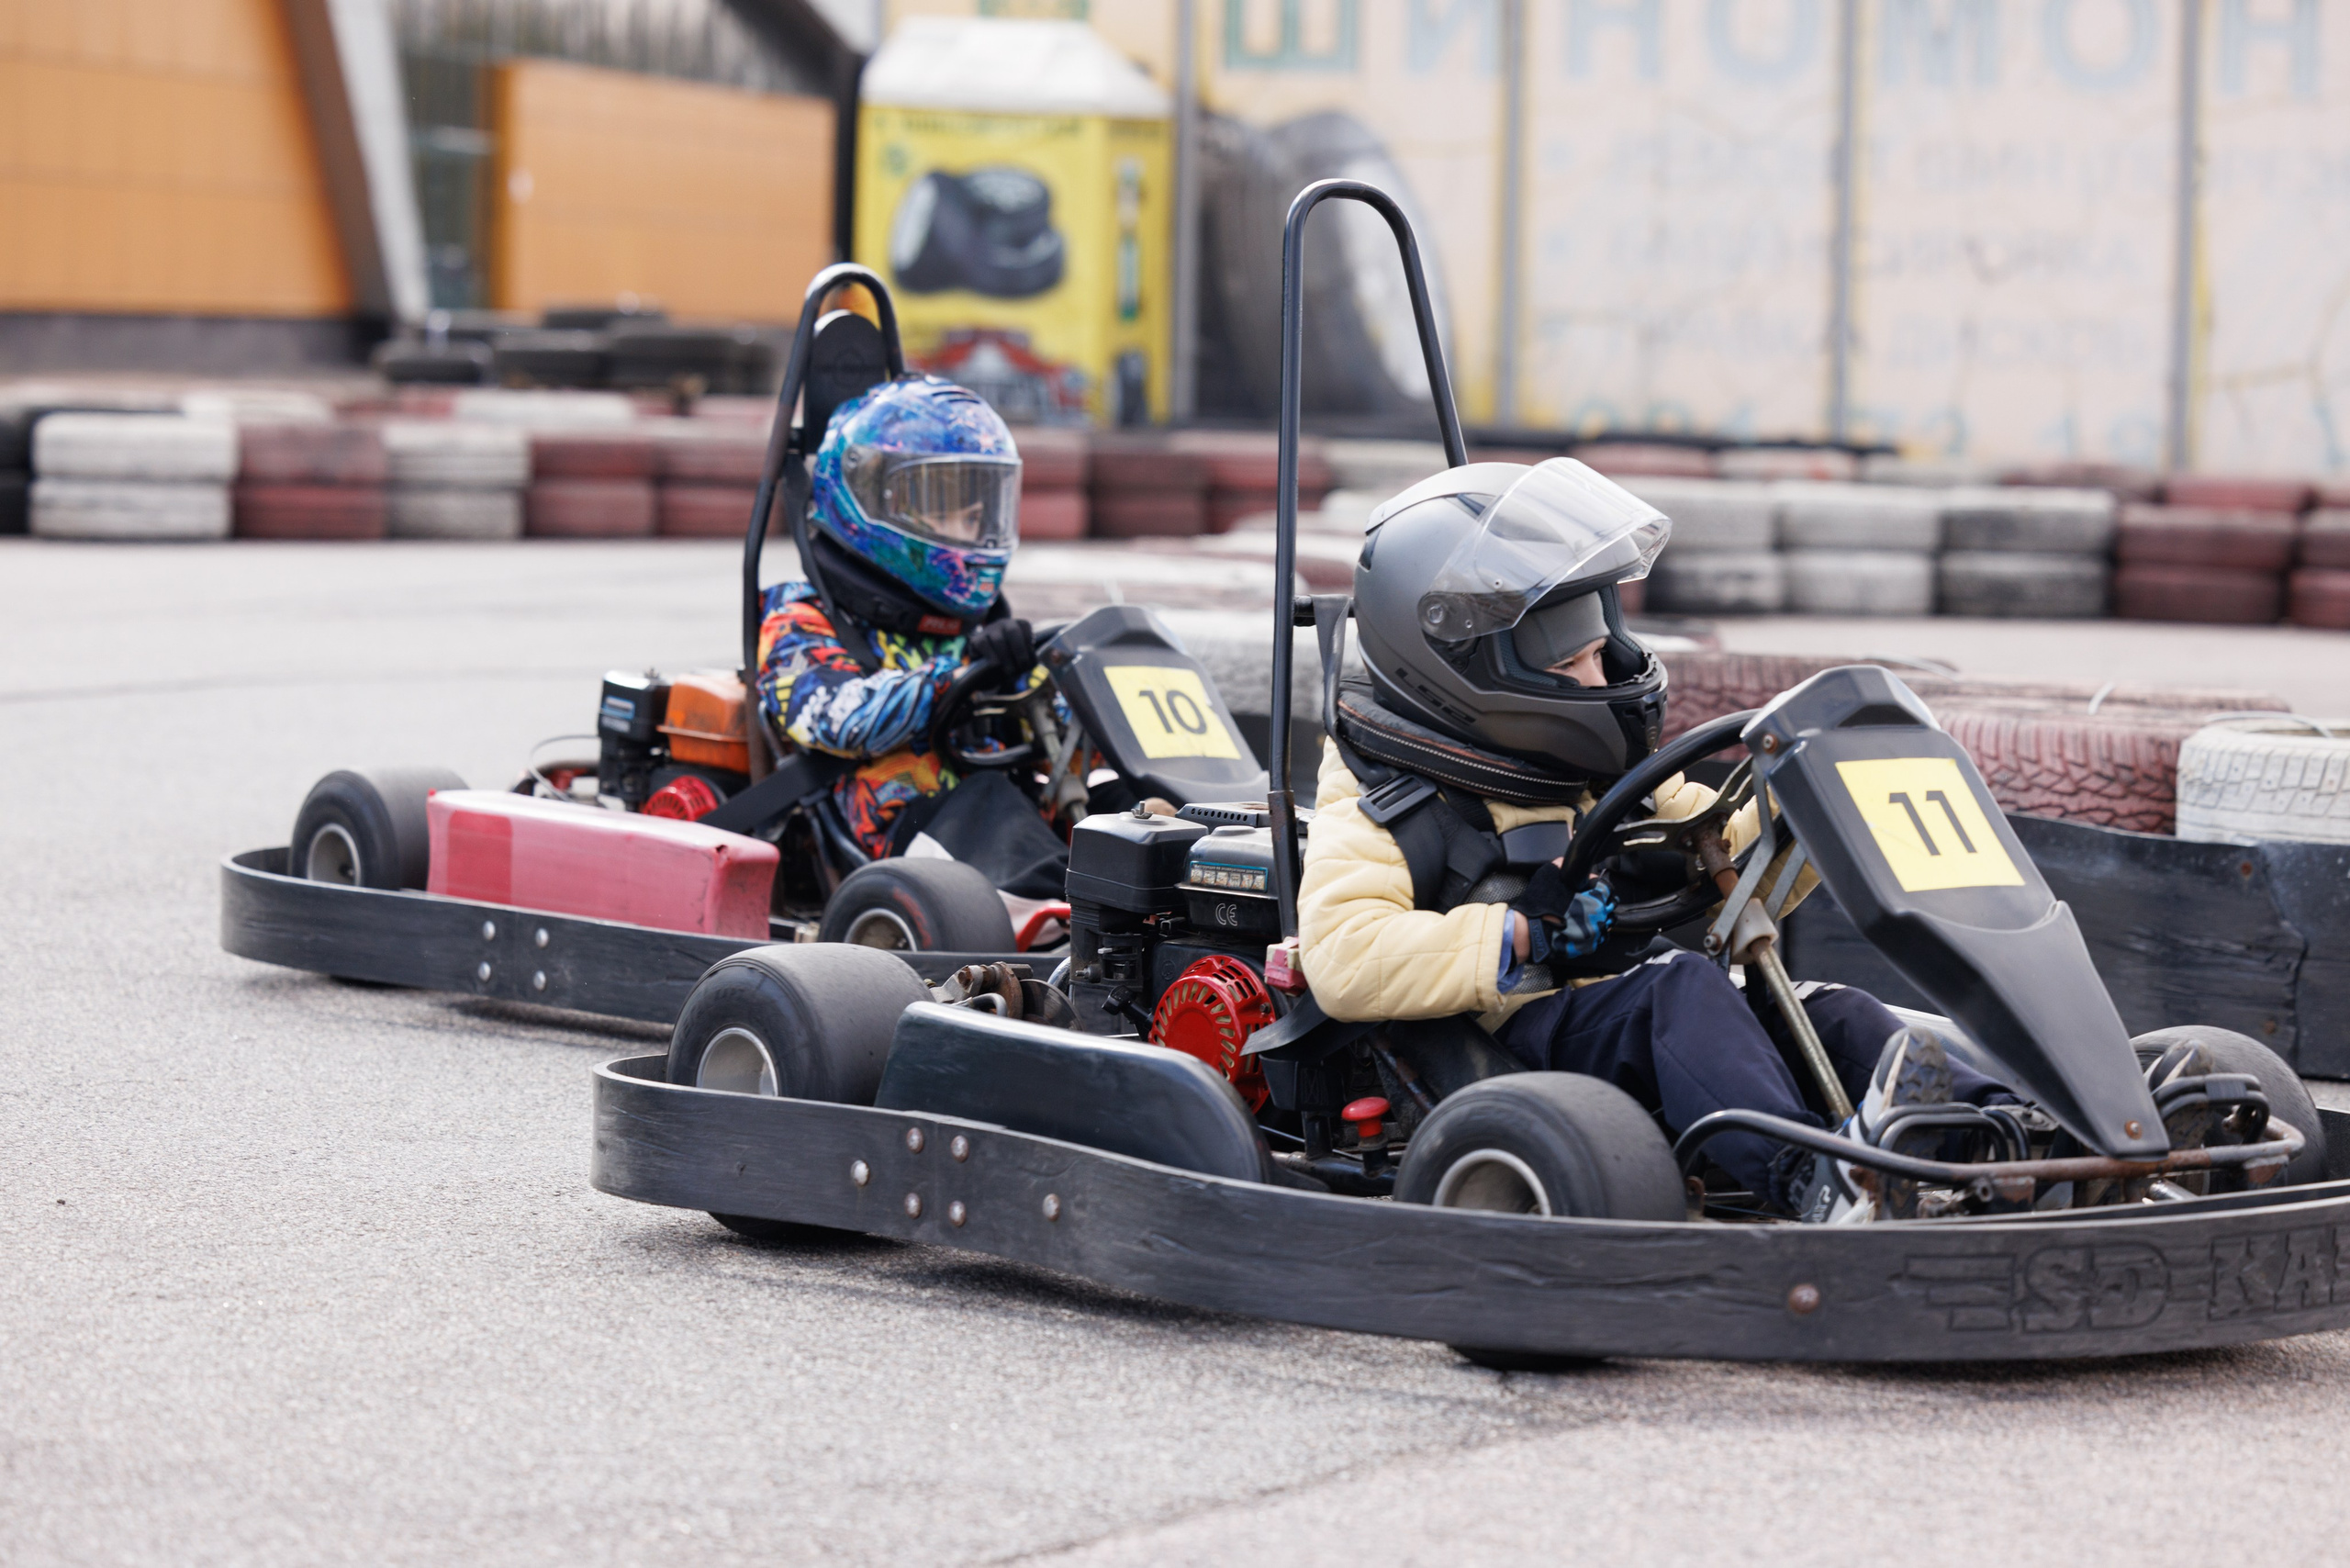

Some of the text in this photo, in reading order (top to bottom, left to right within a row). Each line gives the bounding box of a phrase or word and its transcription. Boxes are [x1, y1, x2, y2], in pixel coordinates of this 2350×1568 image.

[1138, 690, 1207, 734] 10
[1395, 667, 1476, 727] LS2
[1889, 790, 1977, 856] 11
[1215, 903, 1237, 926] CE
